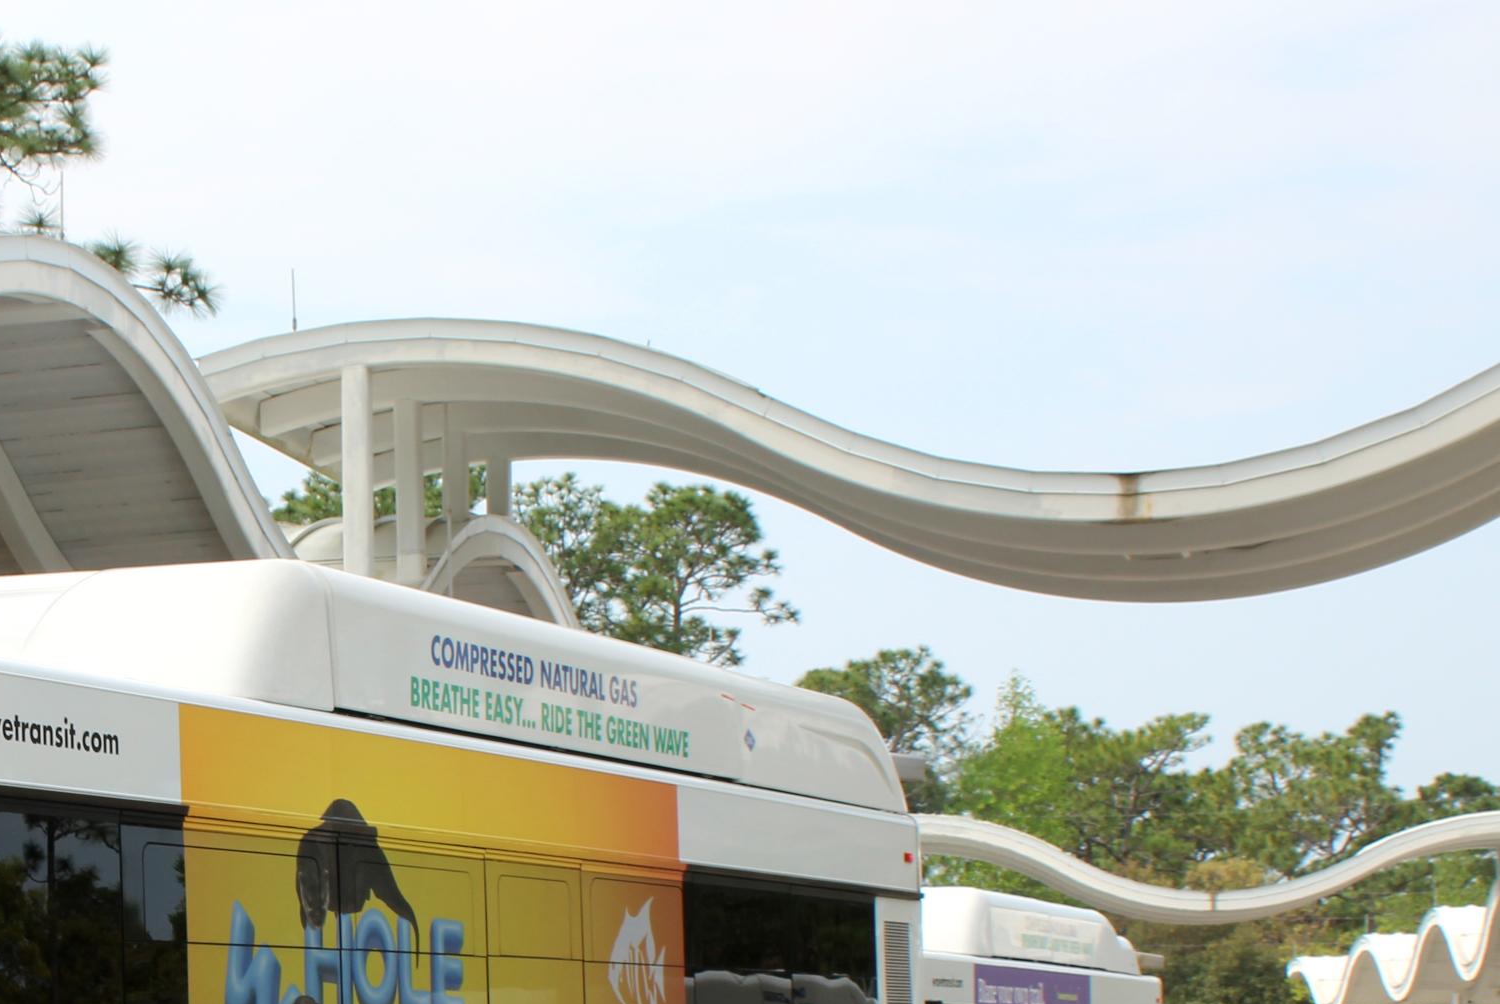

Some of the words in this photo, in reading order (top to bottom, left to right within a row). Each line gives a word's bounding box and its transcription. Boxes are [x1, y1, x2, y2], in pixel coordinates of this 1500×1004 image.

[431, 634, 533, 685] COMPRESSED
[540, 660, 605, 700] NATURAL
[609, 676, 638, 708] GAS
[410, 676, 480, 718] BREATHE
[485, 691, 536, 730] EASY...
[541, 703, 572, 736] RIDE
[577, 713, 601, 741] THE
[606, 716, 650, 751] GREEN
[654, 726, 689, 758] WAVE
